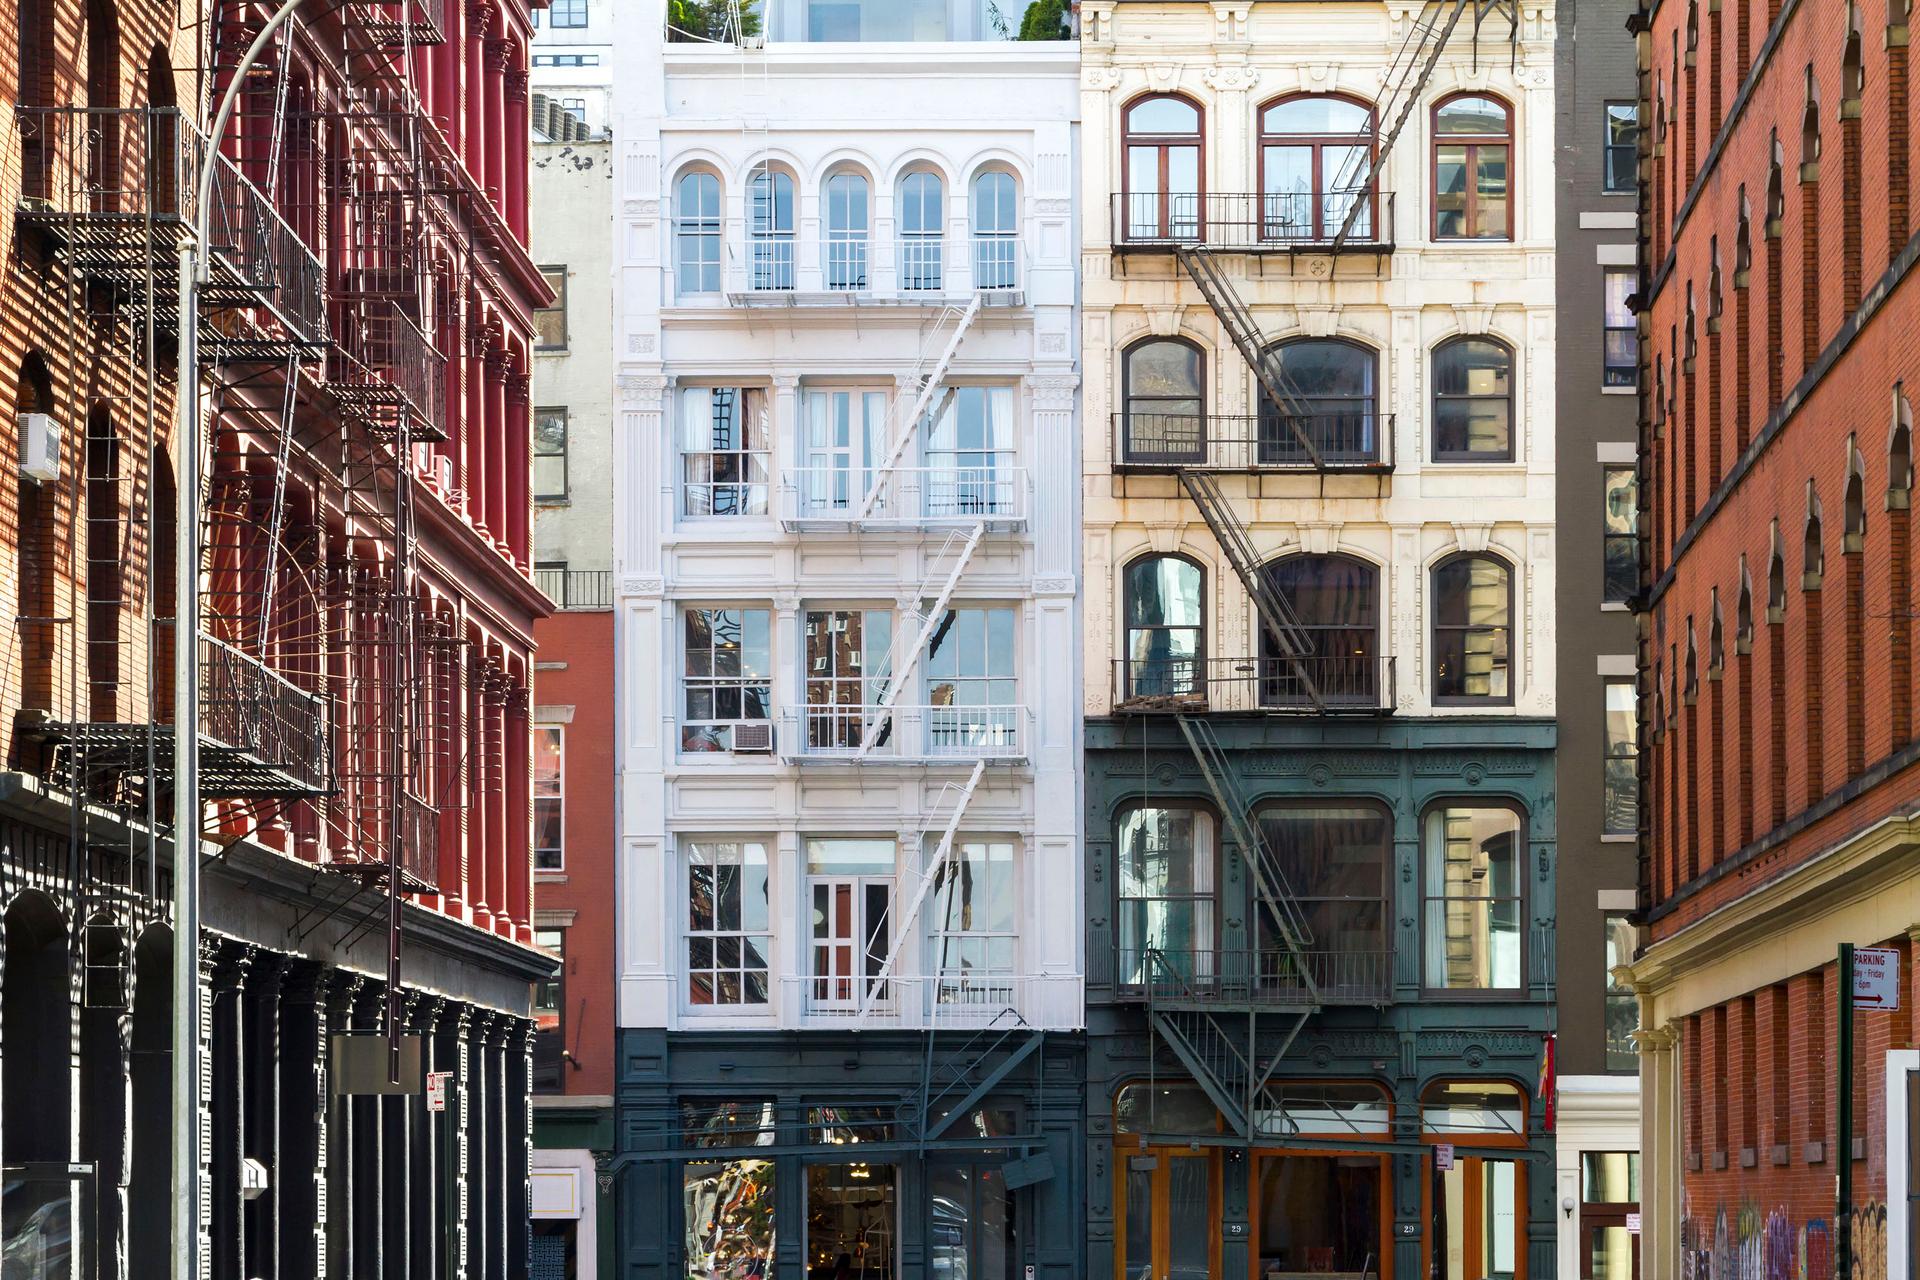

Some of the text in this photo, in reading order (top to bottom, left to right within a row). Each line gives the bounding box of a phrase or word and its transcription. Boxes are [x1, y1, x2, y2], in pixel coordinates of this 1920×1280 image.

[1854, 954, 1885, 966] PARKING
[1868, 969, 1885, 980] Friday
[1859, 980, 1871, 990] 6pm
[1403, 1225, 1414, 1233] 29
